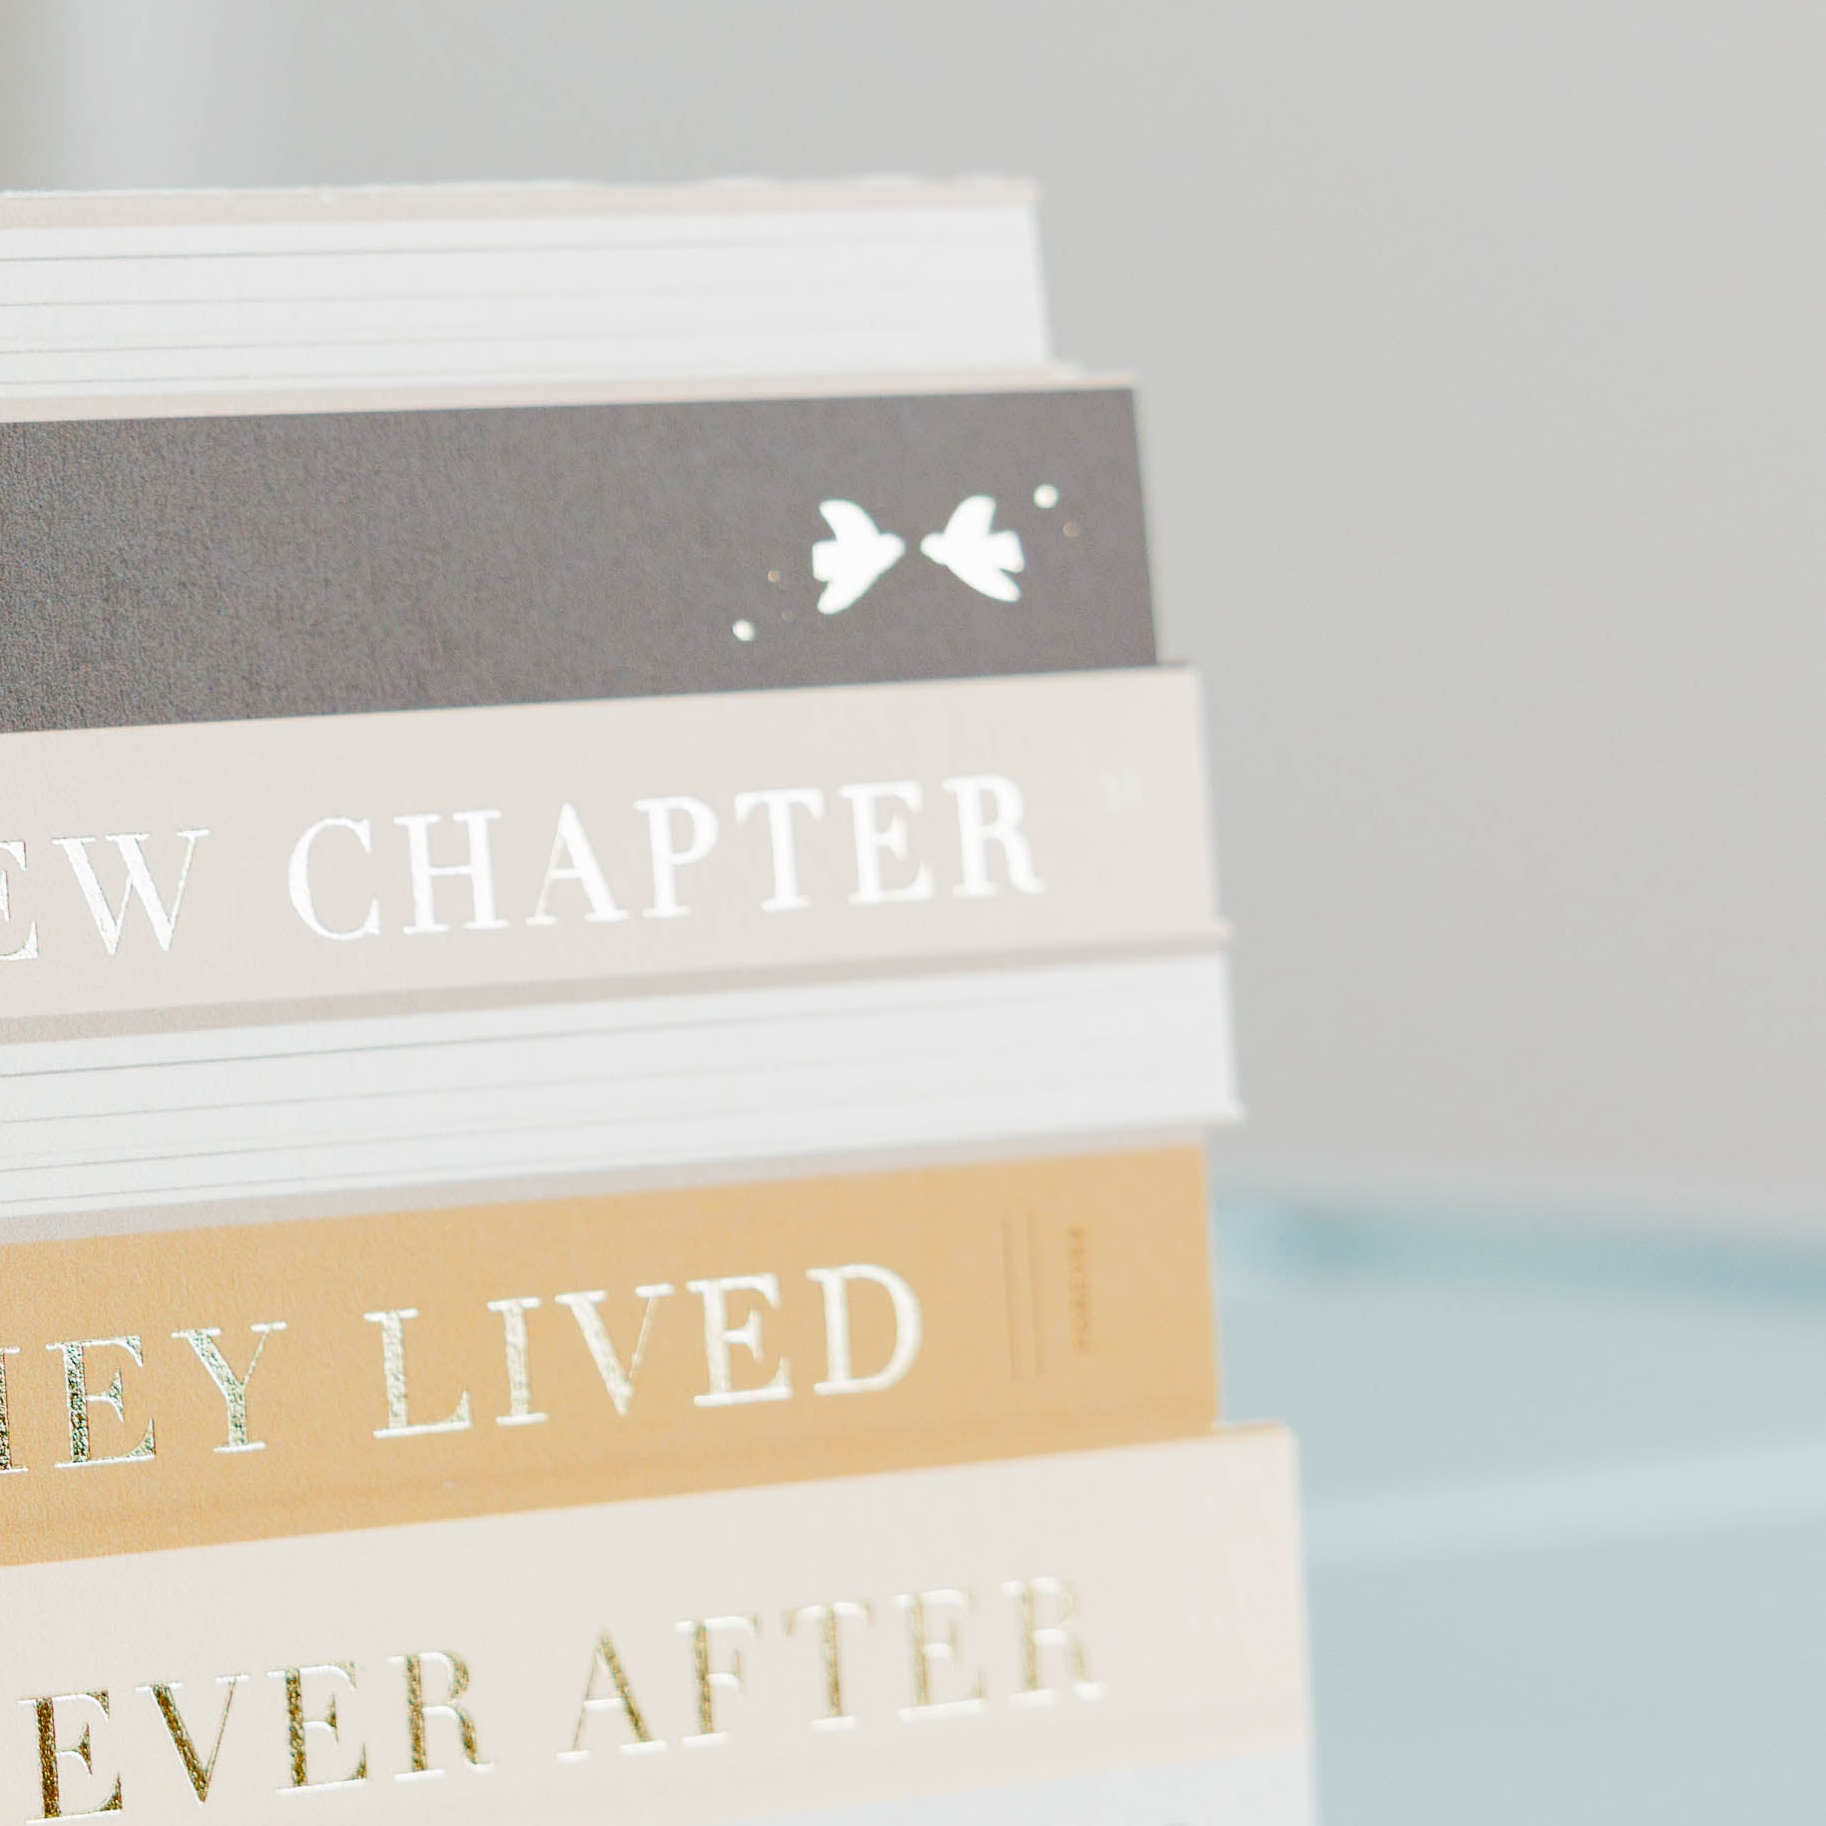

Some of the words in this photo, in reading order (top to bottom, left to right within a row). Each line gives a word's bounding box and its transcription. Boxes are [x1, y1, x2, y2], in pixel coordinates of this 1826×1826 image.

[287, 773, 1044, 941] CHAPTER
[362, 1264, 925, 1438] LIVED
[17, 1651, 492, 1822] EVER
[554, 1576, 1104, 1762] AFTER
